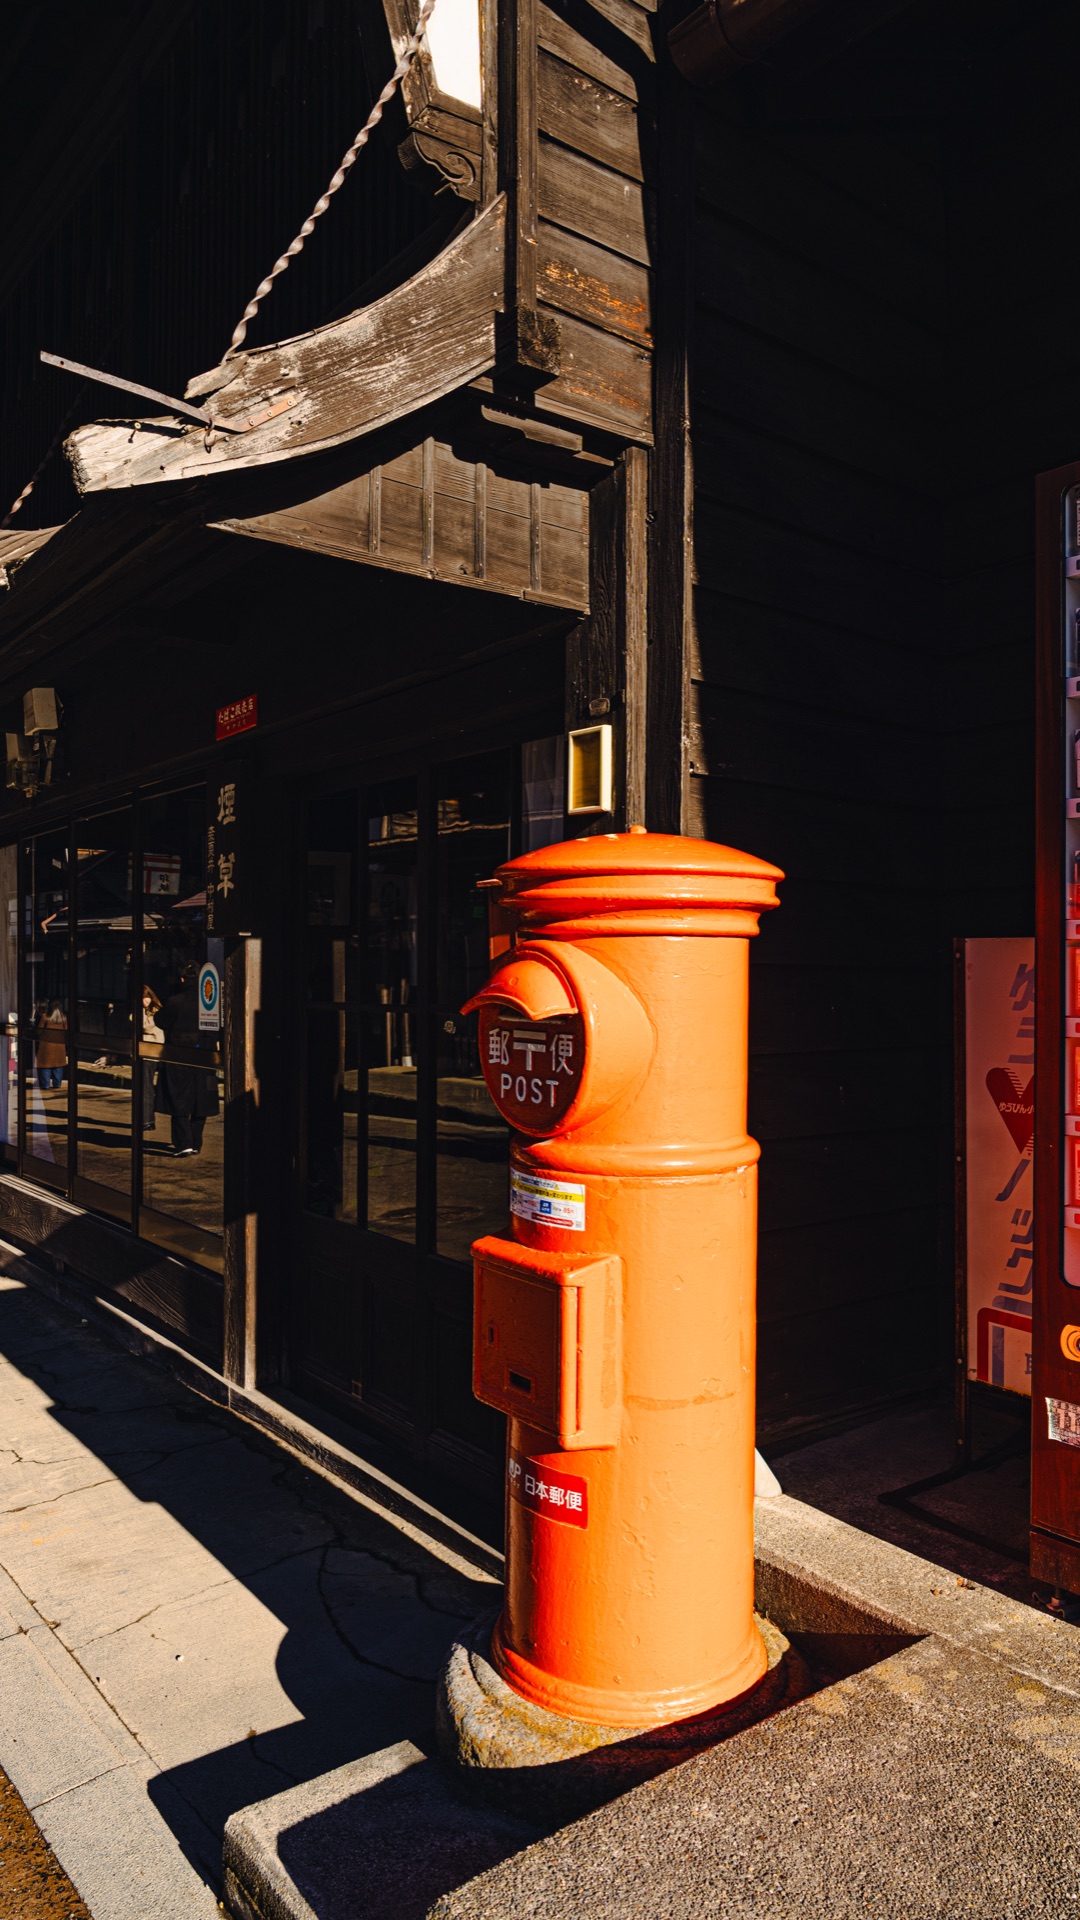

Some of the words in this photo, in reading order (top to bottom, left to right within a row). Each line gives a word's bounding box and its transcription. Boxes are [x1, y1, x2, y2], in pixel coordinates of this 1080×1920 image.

[218, 698, 254, 724] たばこ販売店
[216, 783, 236, 899] 煙草
[500, 1073, 559, 1108] POST
[525, 1474, 583, 1511] 日本郵便
